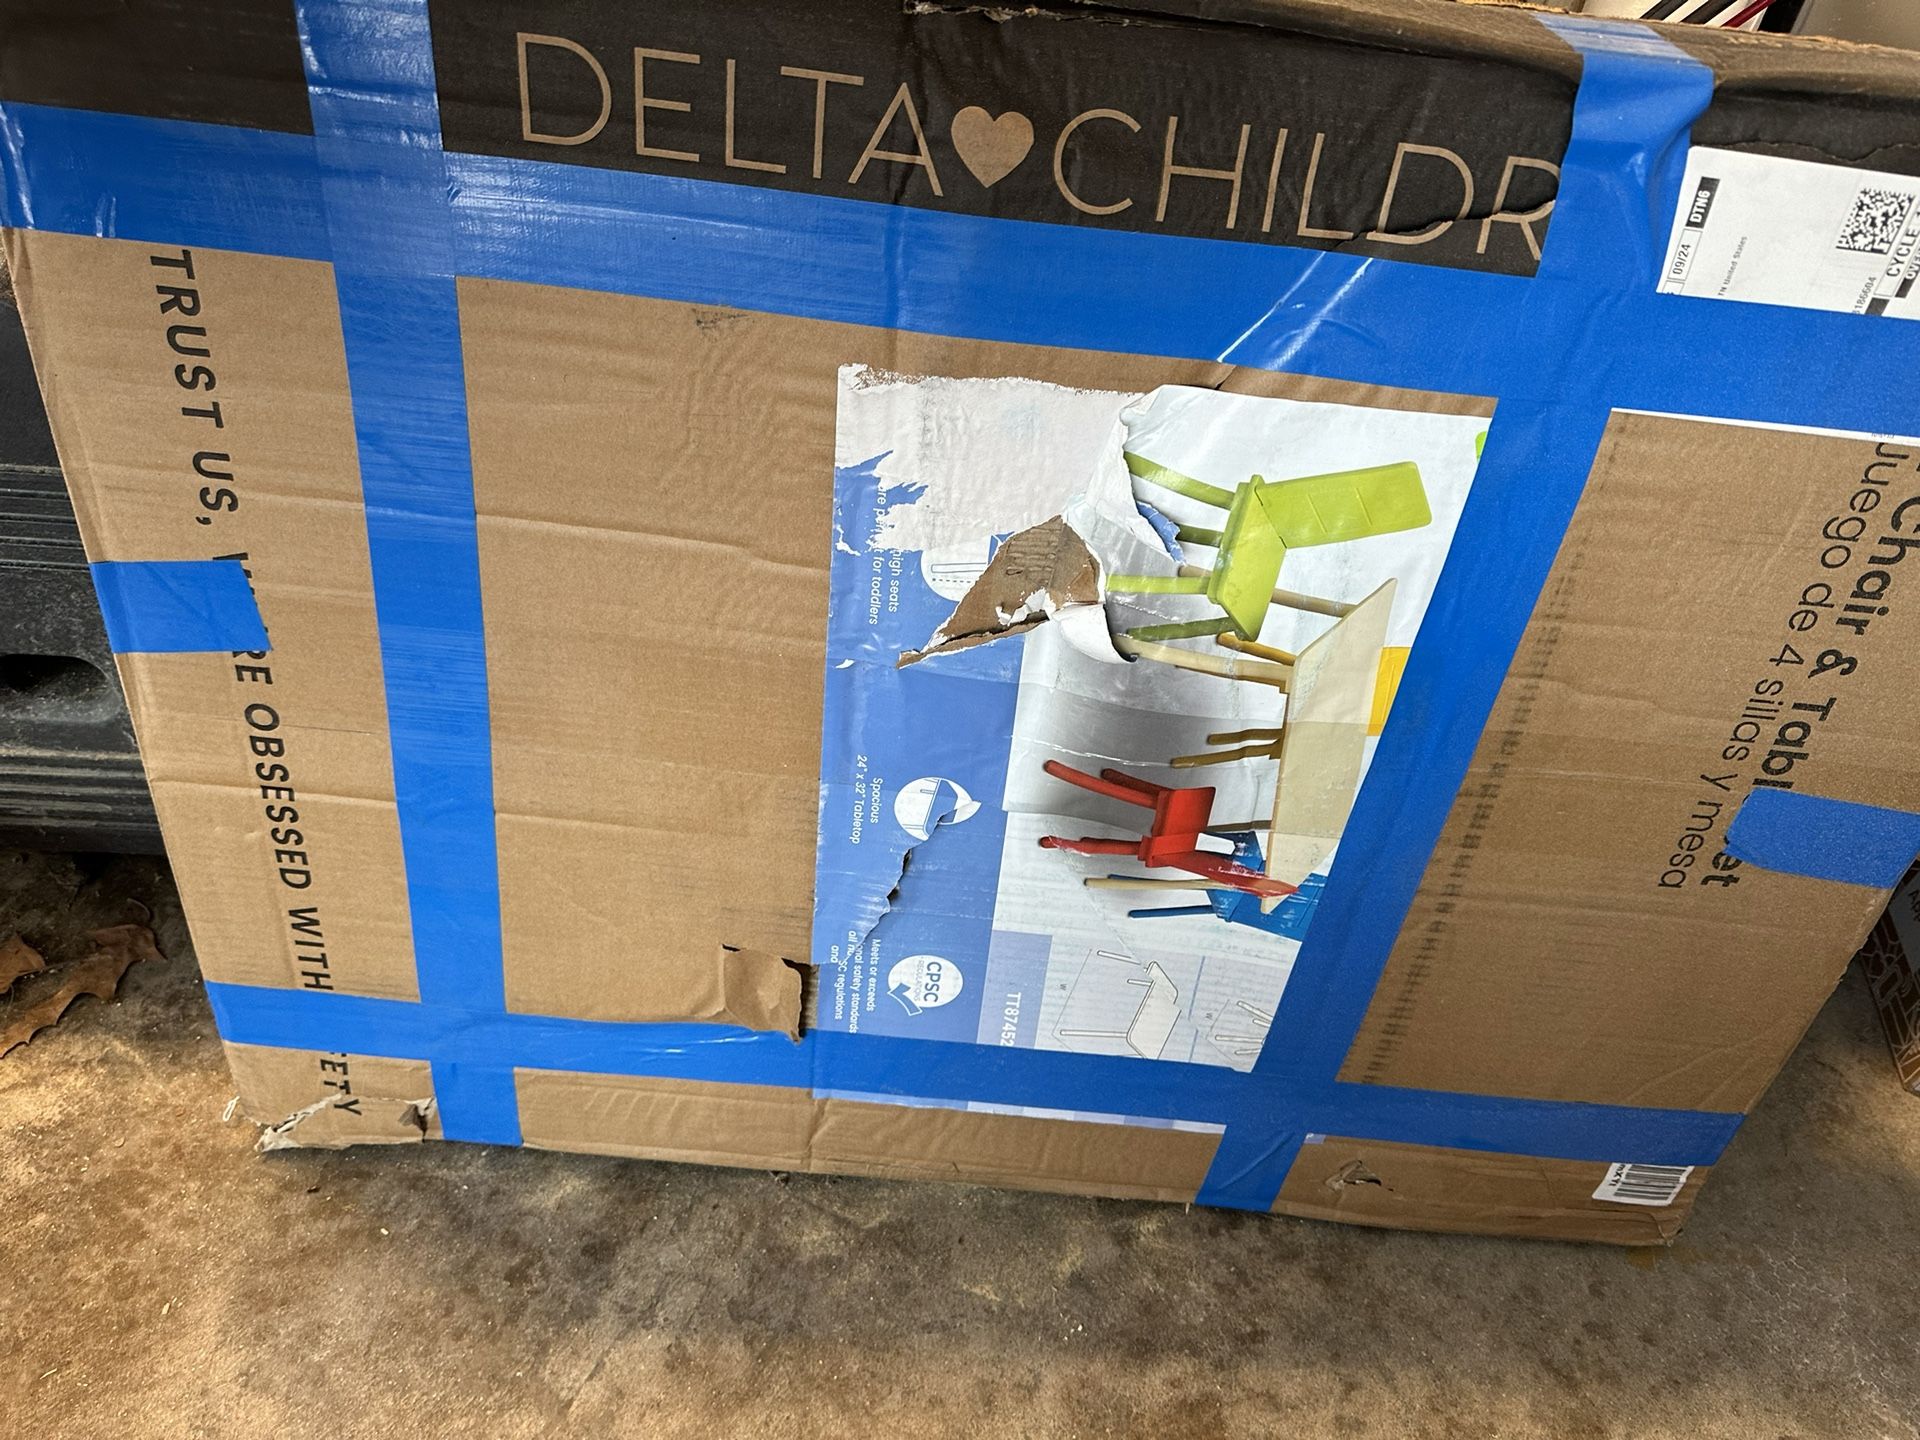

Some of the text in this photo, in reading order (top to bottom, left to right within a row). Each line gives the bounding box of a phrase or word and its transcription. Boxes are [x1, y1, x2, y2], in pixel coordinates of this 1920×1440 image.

[517, 32, 944, 196] DELTA
[1690, 190, 1710, 223] DTN6
[1672, 244, 1691, 275] 09/24
[1723, 261, 1738, 285] United
[1733, 236, 1748, 259] States
[1886, 228, 1919, 277] CYCLE
[1822, 443, 1910, 569] Juego
[873, 556, 884, 574] for
[150, 249, 224, 428] TRUST
[192, 450, 239, 526] US,
[244, 702, 312, 889] OBSESSED
[289, 907, 334, 990] WITH
[869, 576, 882, 625] toddlers
[888, 580, 900, 612] seats
[1788, 582, 1835, 632] de
[1769, 643, 1805, 667] 4
[1808, 648, 1858, 679] &
[1721, 678, 1784, 762] sillas
[1743, 697, 1838, 800] Tabl
[870, 777, 884, 824] Spacious
[1700, 773, 1739, 792] y
[849, 800, 865, 845] Tabletop
[1658, 800, 1723, 888] mesa
[1701, 838, 1744, 887] et
[830, 944, 840, 964] and
[848, 930, 858, 943] all
[834, 973, 846, 1020] regulations
[850, 964, 864, 992] safety
[866, 938, 882, 1012] Meets or exceeds
[923, 961, 942, 1003] CPSC
[849, 992, 861, 1034] standards
[1000, 991, 1022, 1047] TT87452
